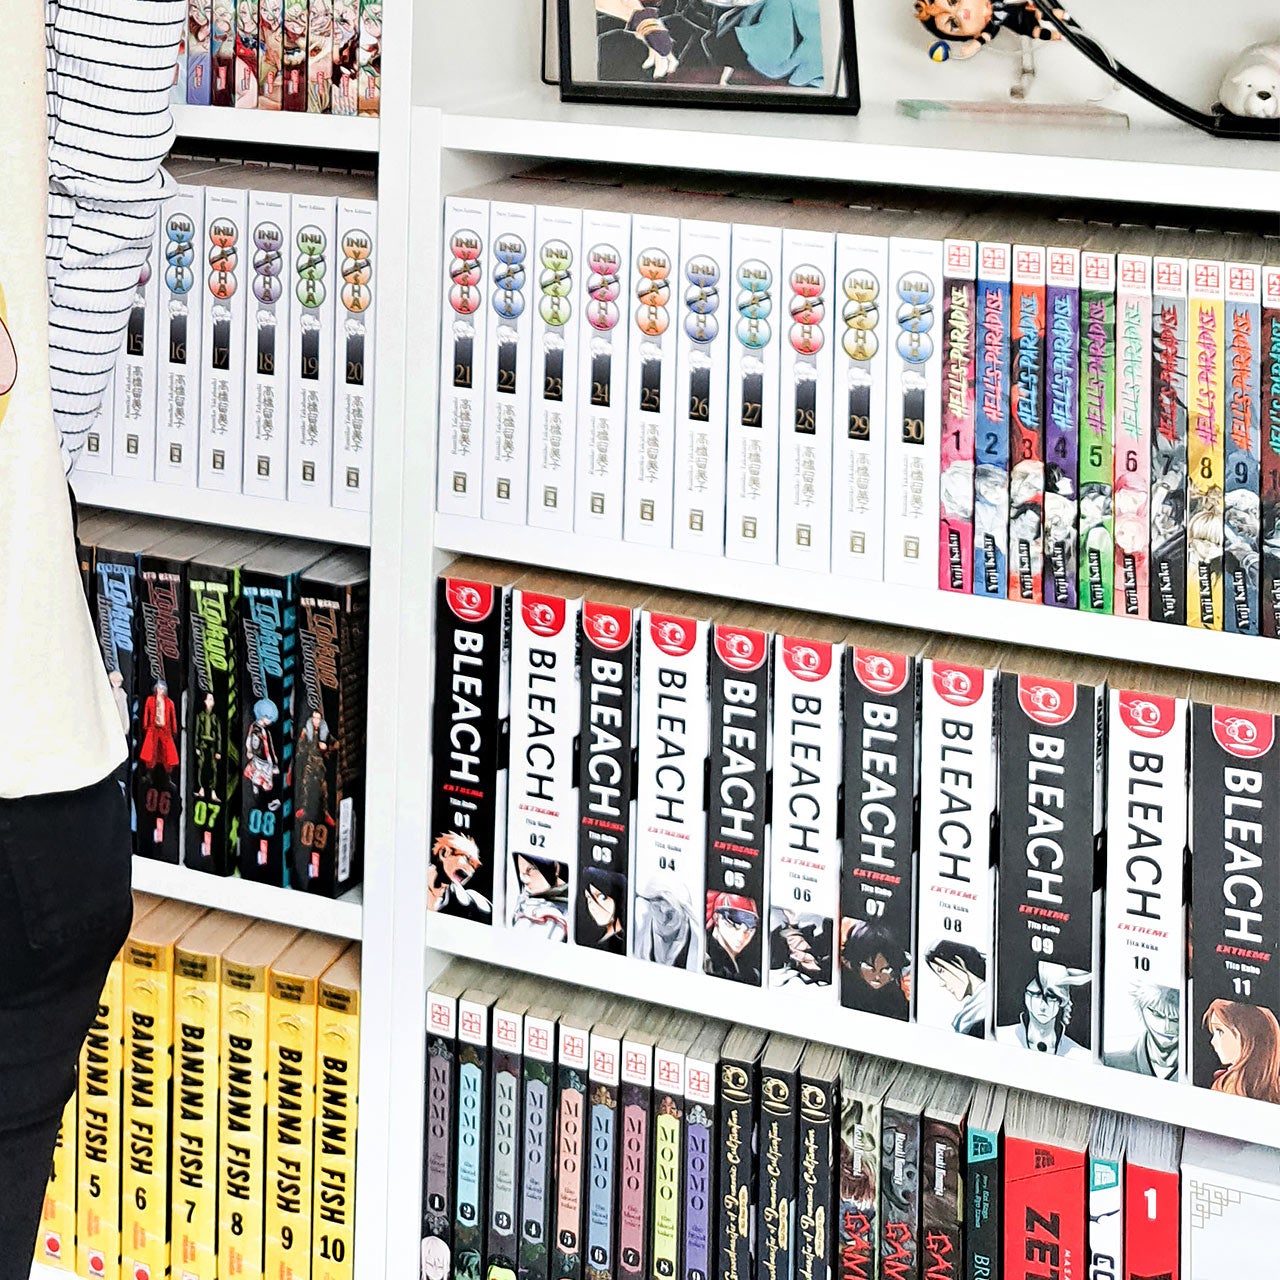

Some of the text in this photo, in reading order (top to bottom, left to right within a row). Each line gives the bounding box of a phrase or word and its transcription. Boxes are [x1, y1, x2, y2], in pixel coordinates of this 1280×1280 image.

[171, 343, 185, 360] 16
[258, 353, 273, 370] 18
[347, 362, 362, 380] 20
[455, 365, 471, 384] 21
[545, 377, 562, 397] 23
[592, 382, 609, 402] 24
[952, 430, 961, 450] 1
[986, 432, 999, 455] 2
[1090, 446, 1102, 467] 5
[1124, 558, 1138, 614] Yuji Kaku
[1159, 562, 1175, 618] Yuji Kaku
[449, 629, 484, 784] BLEACH
[526, 647, 556, 802] BLEACH
[587, 658, 623, 817] BLEACH
[656, 667, 687, 824] BLEACH
[720, 677, 757, 842] BLEACH
[789, 692, 821, 854] BLEACH
[859, 701, 898, 868] BLEACH
[938, 718, 974, 884] BLEACH
[194, 802, 220, 828] 07
[249, 811, 275, 836] 08
[1025, 733, 1065, 906] BLEACH
[301, 823, 327, 848] 09
[530, 834, 545, 849] 02
[659, 857, 675, 872] 04
[725, 870, 744, 888] 05
[944, 918, 961, 932] 08
[1019, 905, 1070, 922] EXTREME
[1117, 923, 1168, 938] EXTREME
[1031, 936, 1054, 954] 09
[1133, 956, 1150, 971] 10
[1233, 978, 1251, 996] 11
[130, 1010, 154, 1175] BANANA FISH
[432, 1067, 446, 1139] MOMO
[179, 1023, 204, 1188] BANANA FISH
[226, 1034, 252, 1200] BANANA FISH
[463, 1074, 478, 1147] MOMO
[529, 1090, 543, 1165] MOMO
[564, 1099, 579, 1174] MOMO
[320, 1055, 348, 1225] BANANA FISH
[89, 1175, 101, 1198] 5
[134, 1188, 147, 1210] 6
[1144, 1188, 1157, 1220] 1
[186, 1200, 196, 1223] 7
[463, 1206, 471, 1219] 2
[564, 1232, 572, 1246] 5
[627, 1251, 635, 1264] 7
